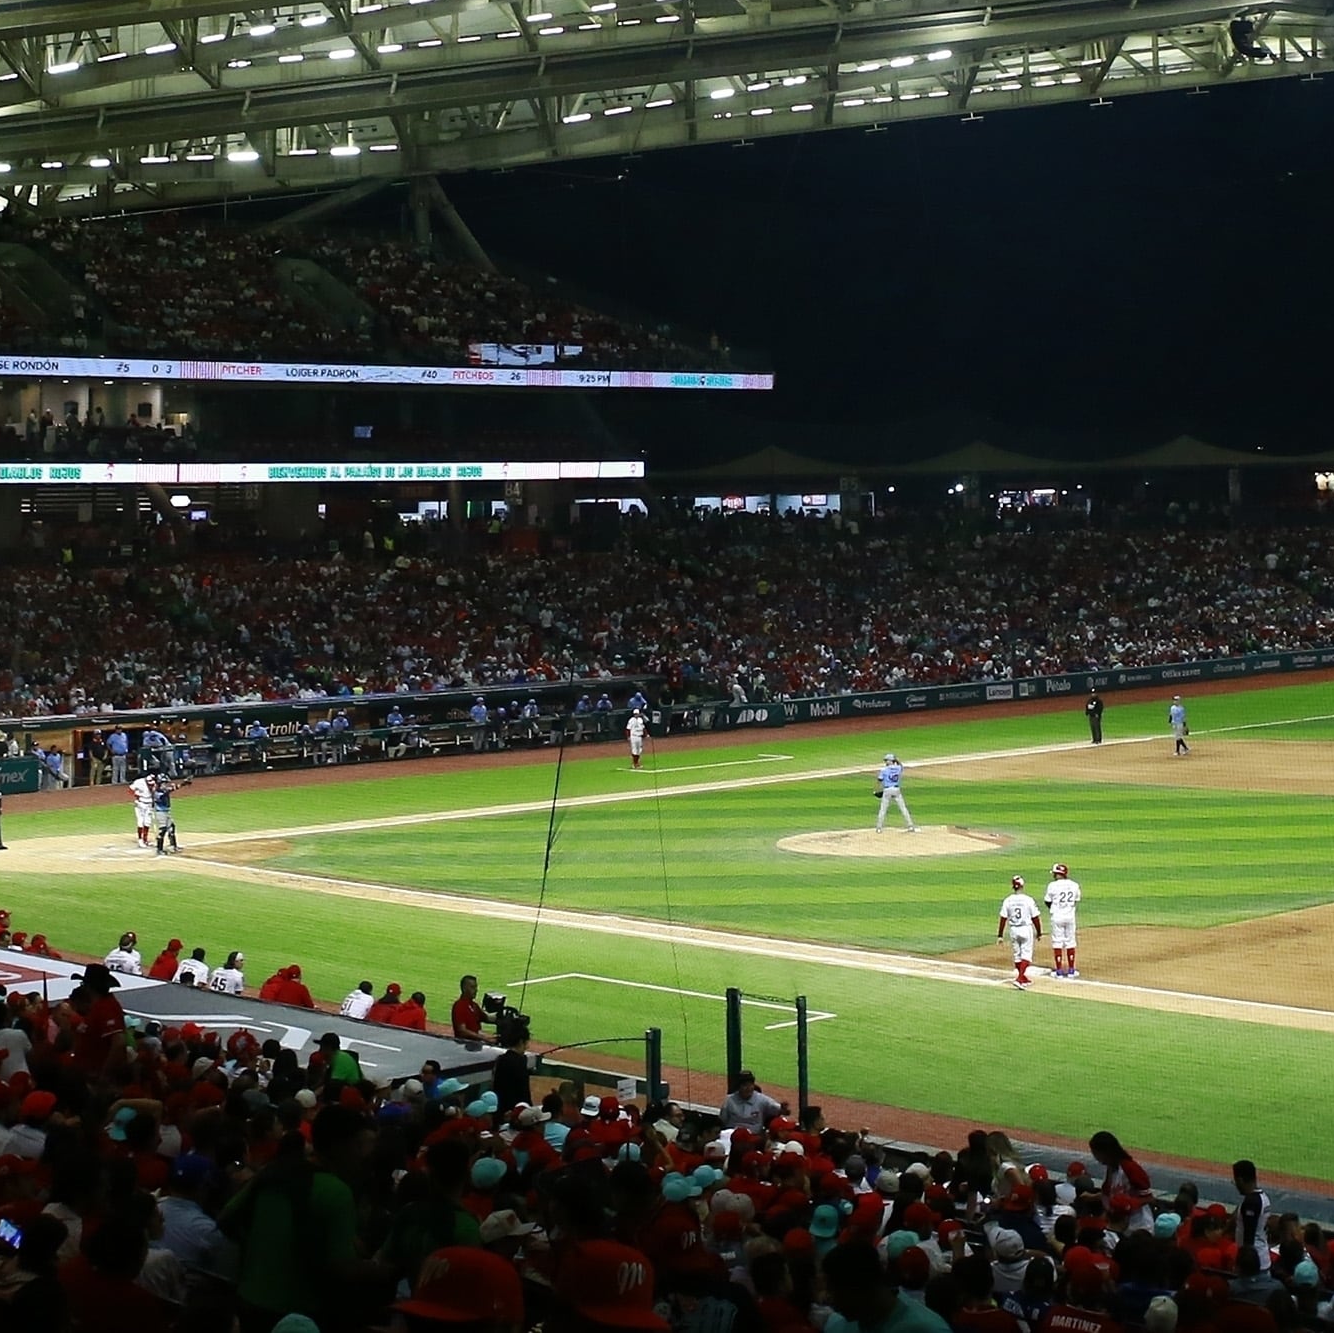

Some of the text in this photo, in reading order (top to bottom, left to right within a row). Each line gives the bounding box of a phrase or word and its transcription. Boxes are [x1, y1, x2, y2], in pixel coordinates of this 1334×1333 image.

[12, 358, 60, 371] RONDÓN
[165, 364, 173, 374] 3
[222, 365, 262, 376] PITCHER
[452, 371, 495, 381] PITCHEOS
[509, 372, 522, 381] 26
[0, 467, 43, 480] DIABLOS
[1045, 679, 1072, 693] Pétalo
[809, 702, 841, 717] Mobil
[861, 698, 892, 709] Profuturo
[736, 708, 769, 724] ADO
[1058, 890, 1075, 904] 22
[1013, 906, 1023, 920] 3
[210, 976, 227, 992] 45
[1050, 1314, 1103, 1333] MARTINEZ
